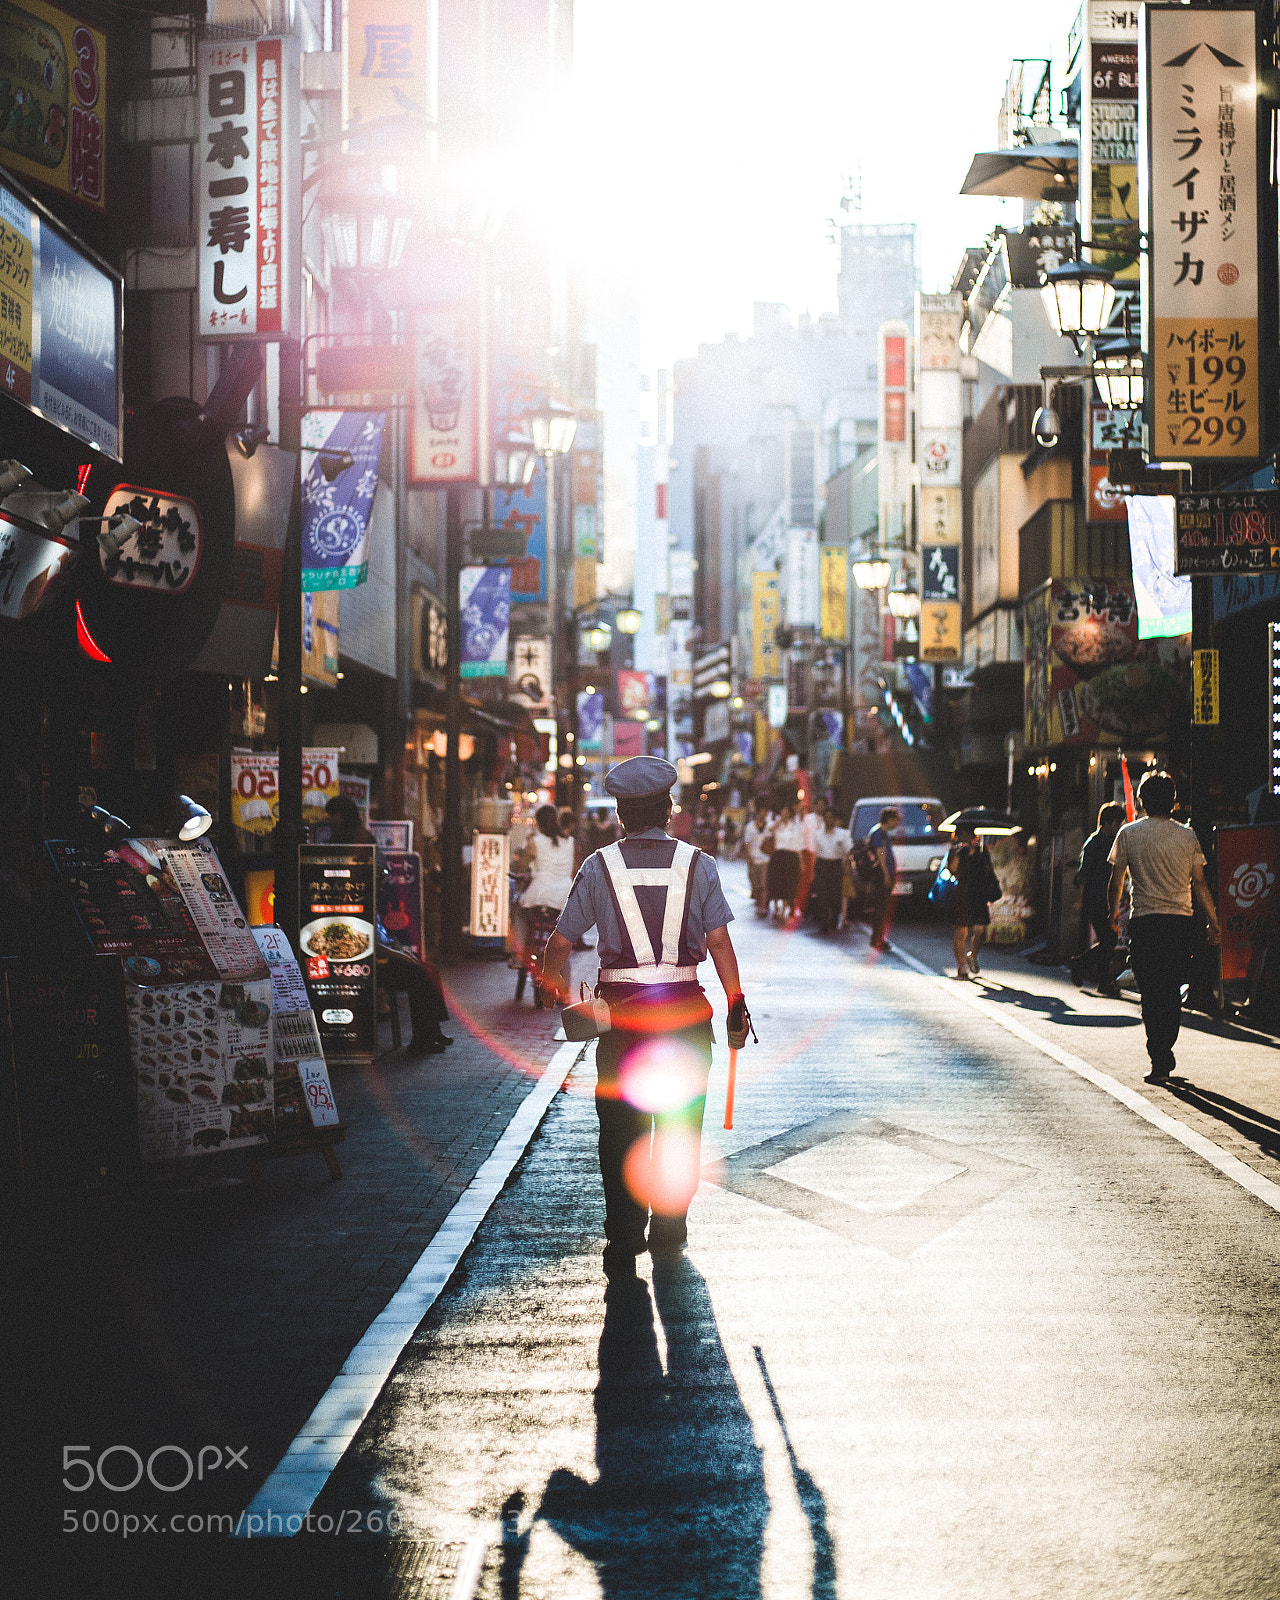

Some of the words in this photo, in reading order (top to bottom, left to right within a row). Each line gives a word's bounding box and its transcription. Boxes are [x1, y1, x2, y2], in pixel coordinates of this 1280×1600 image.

[1092, 105, 1136, 120] STUDIO
[206, 70, 251, 305] 日本一寿し
[1171, 83, 1210, 287] ミライザカ
[1167, 328, 1246, 353] ハイボール
[1167, 388, 1246, 414] 生ビール
[263, 933, 281, 950] 2F
